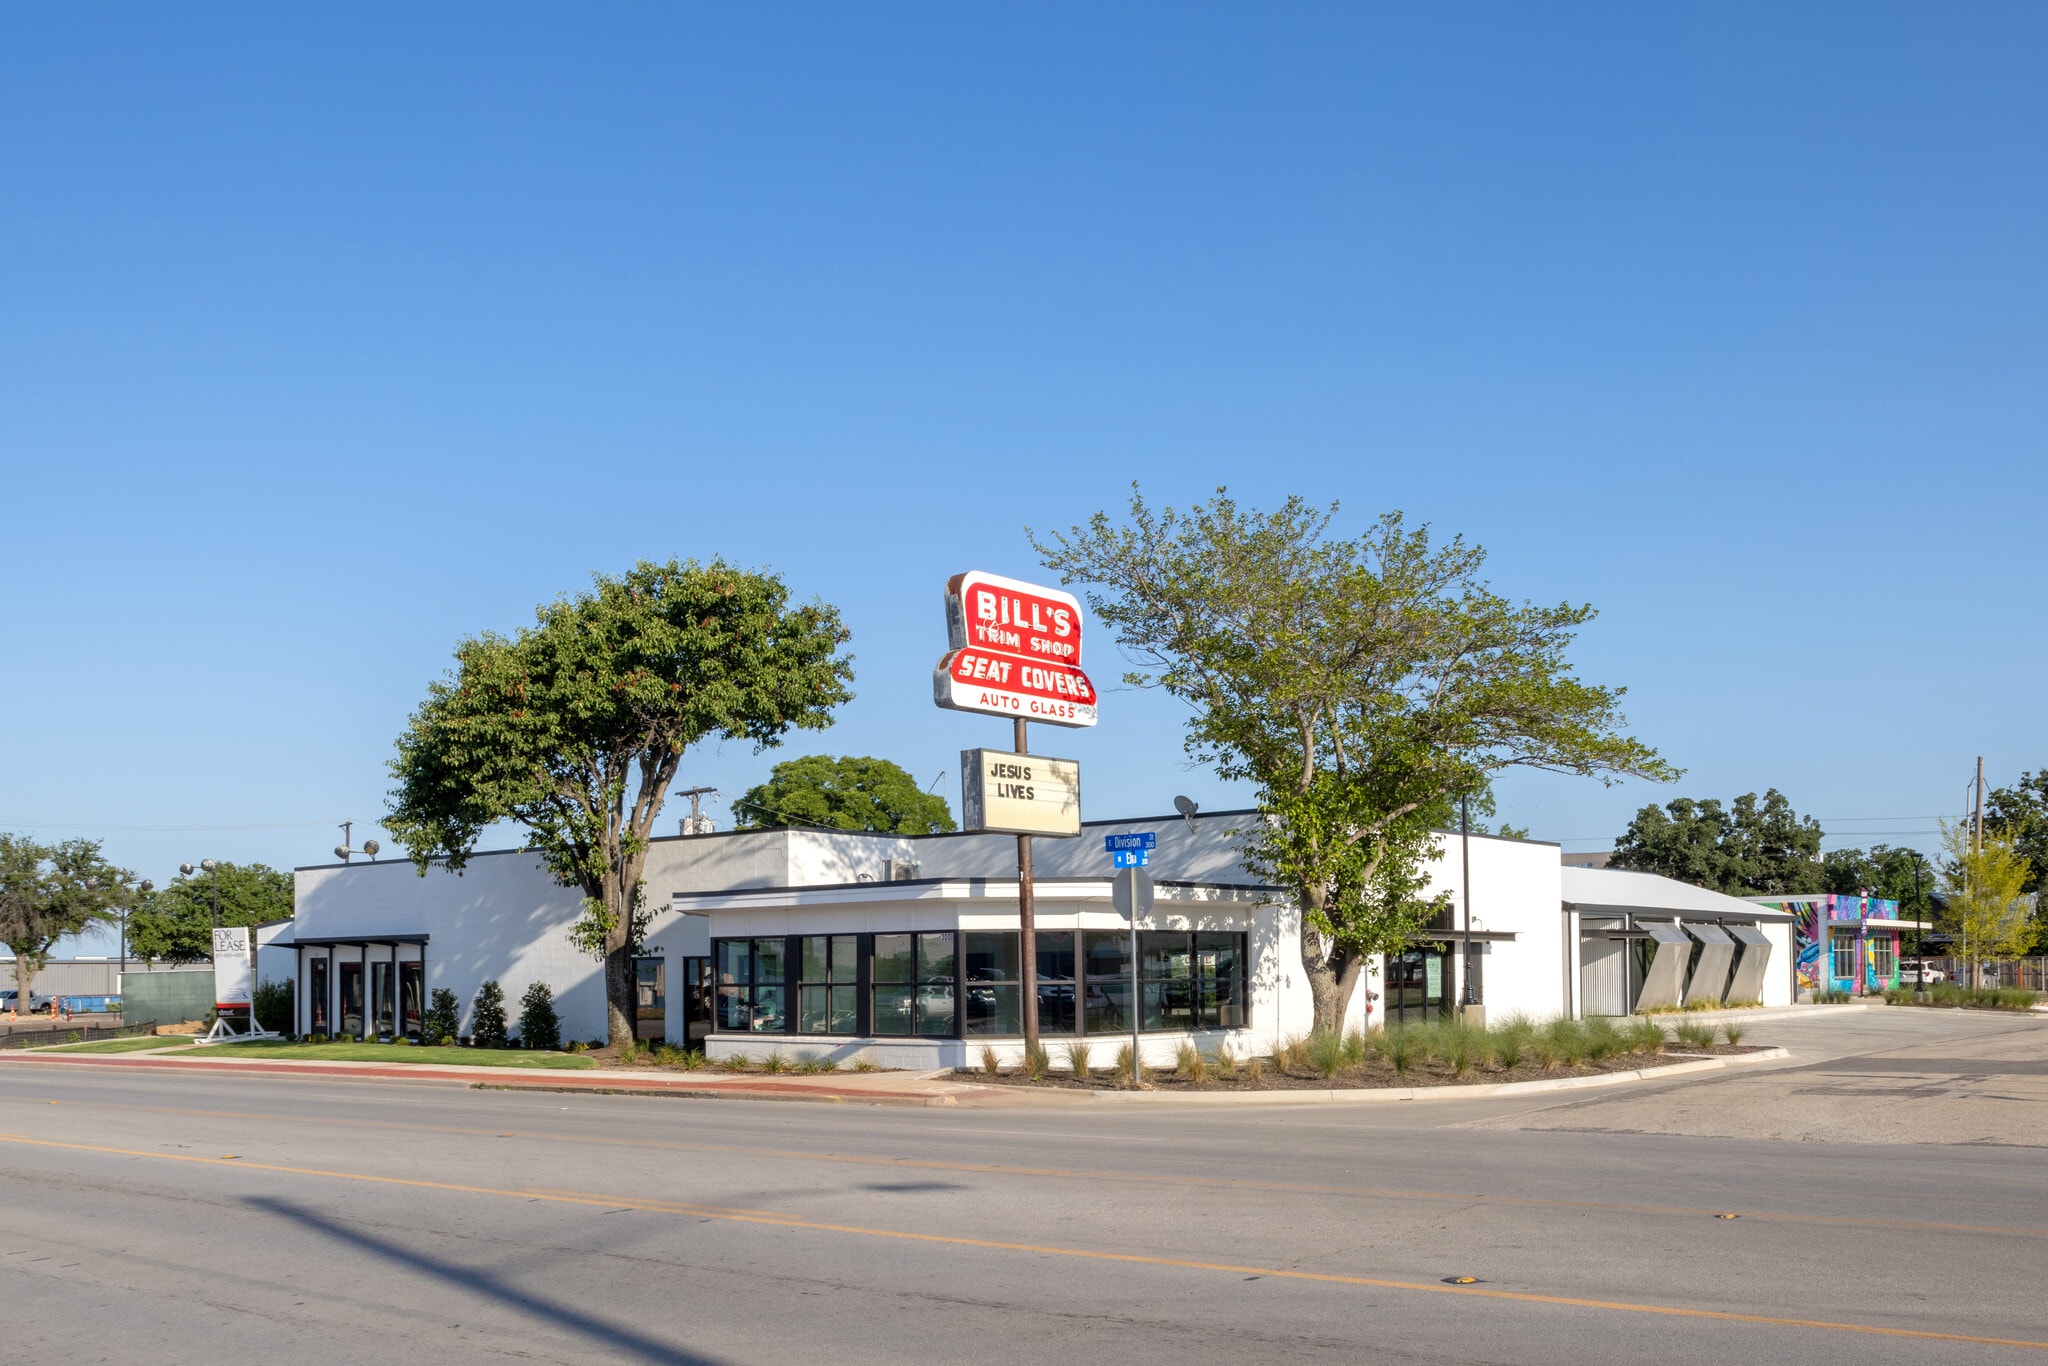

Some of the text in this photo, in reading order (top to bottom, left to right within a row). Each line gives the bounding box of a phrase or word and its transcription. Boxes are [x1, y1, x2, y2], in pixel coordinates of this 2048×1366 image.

[977, 590, 1071, 636] BILL'S
[976, 625, 1075, 657] TRIM SHOP
[958, 655, 1090, 698] SEAT COVERS
[980, 692, 1020, 709] AUTO
[1030, 701, 1075, 718] GLASS
[991, 763, 1031, 781] JESUS
[997, 783, 1034, 800] LIVES
[1114, 836, 1141, 848] Division
[214, 929, 232, 941] FOR
[215, 940, 246, 951] LEASE
